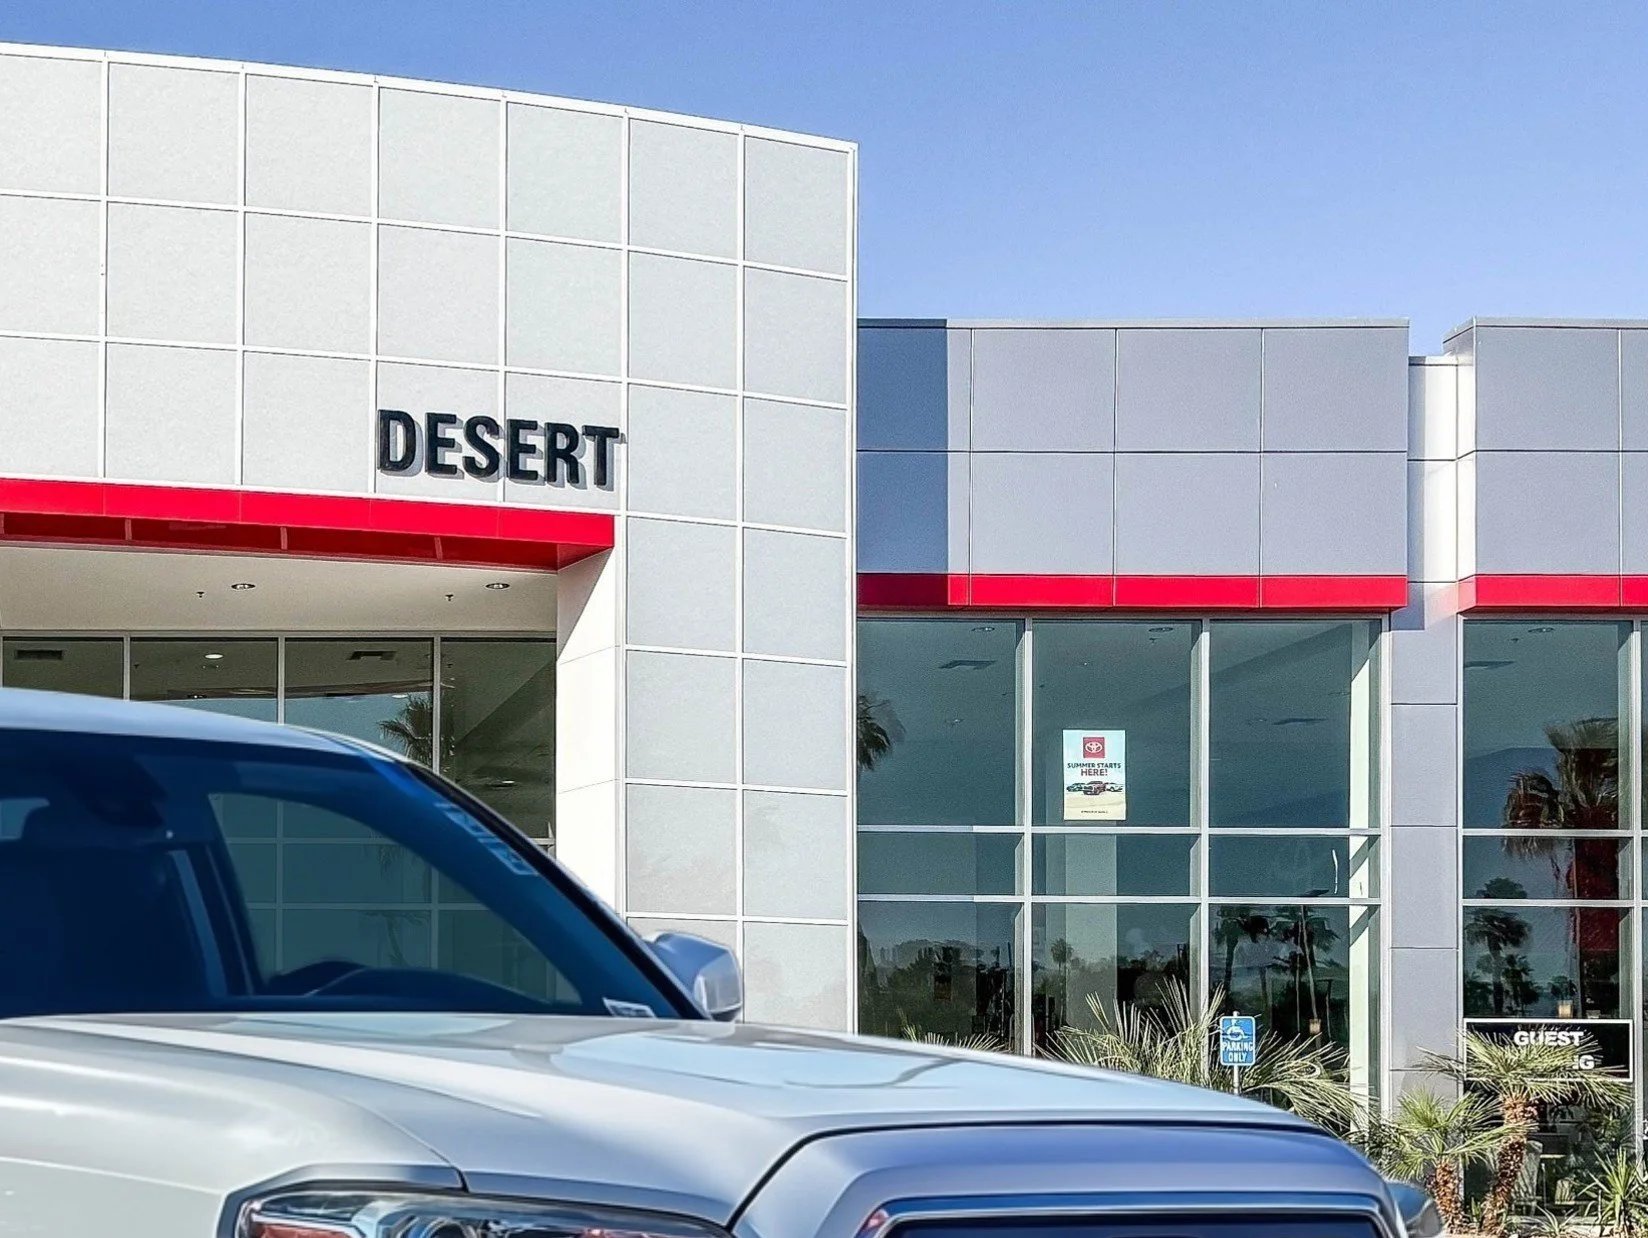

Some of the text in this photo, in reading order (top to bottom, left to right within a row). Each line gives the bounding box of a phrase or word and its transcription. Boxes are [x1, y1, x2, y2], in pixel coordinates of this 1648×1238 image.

[377, 409, 620, 487] DESERT
[1080, 768, 1108, 776] HERE!
[1513, 1031, 1585, 1046] GUEST
[1221, 1041, 1254, 1052] PARKING
[1228, 1052, 1248, 1062] ONLY
